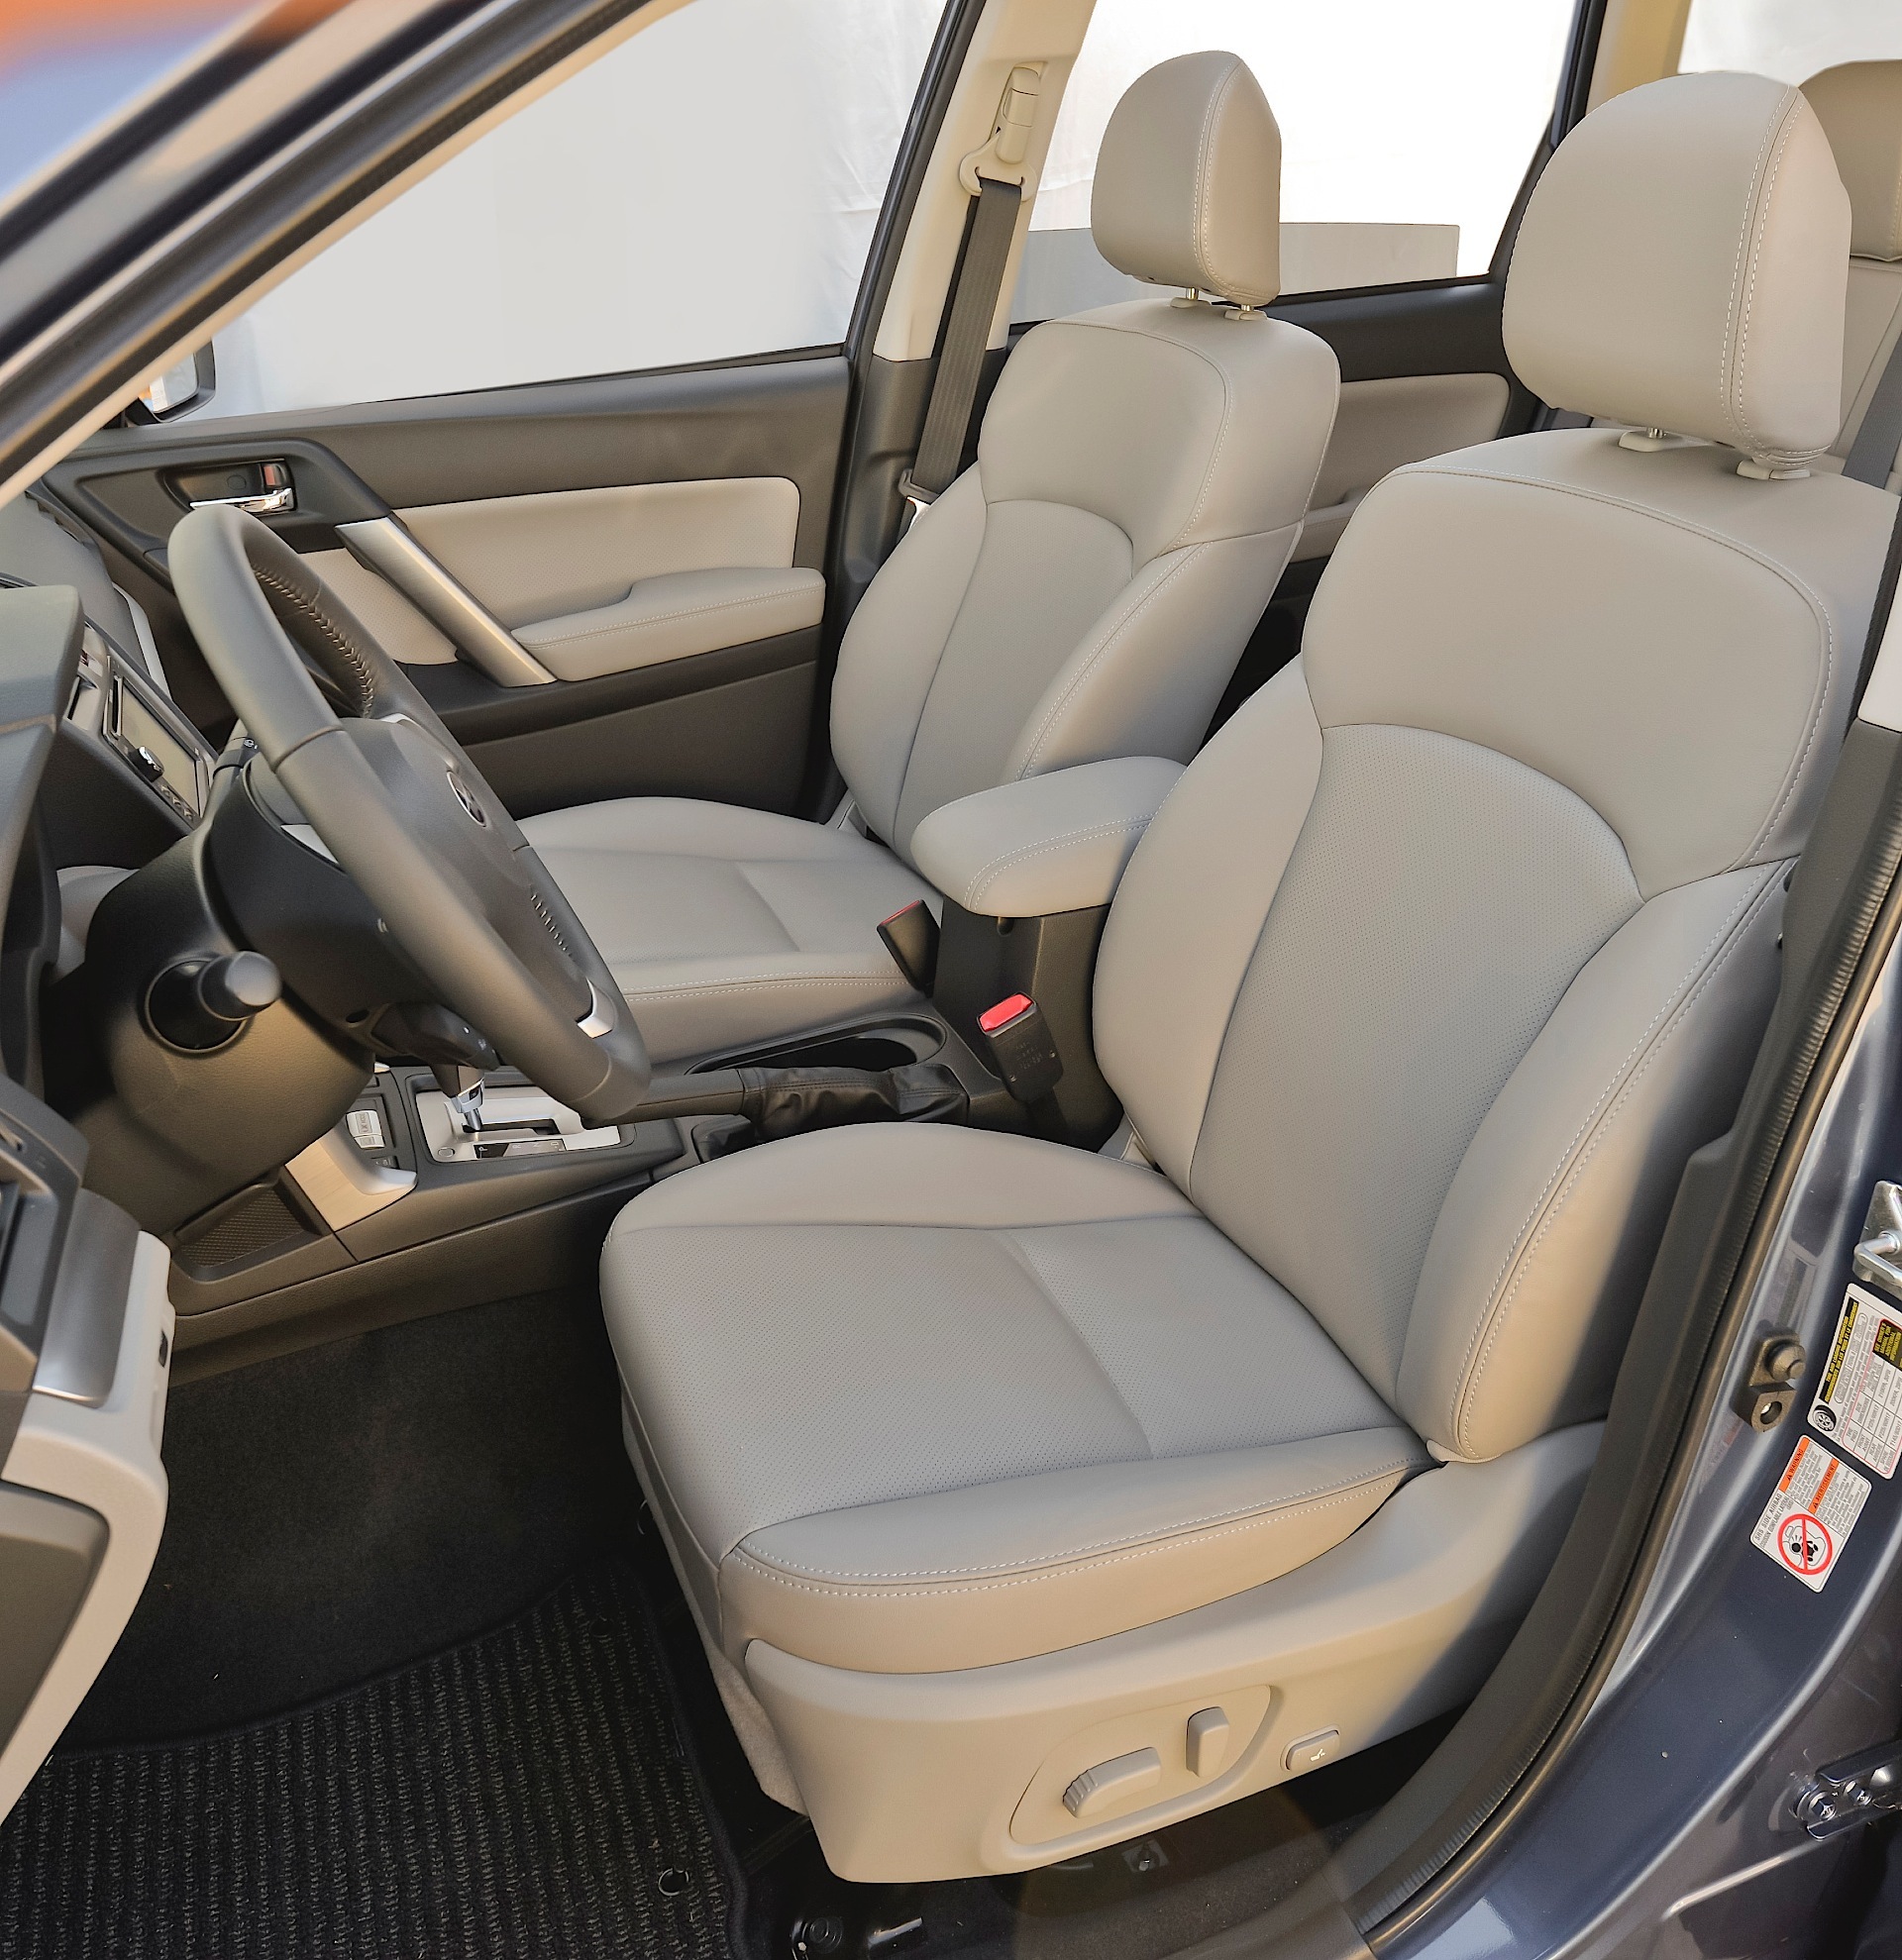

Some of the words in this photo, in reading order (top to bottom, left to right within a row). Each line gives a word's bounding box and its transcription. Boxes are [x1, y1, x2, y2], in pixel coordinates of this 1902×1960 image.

[1788, 1447, 1803, 1474] WARNING
[1754, 1527, 1764, 1541] SRS
[1760, 1513, 1771, 1528] SIDE
[1767, 1491, 1782, 1514] AIRBAG
